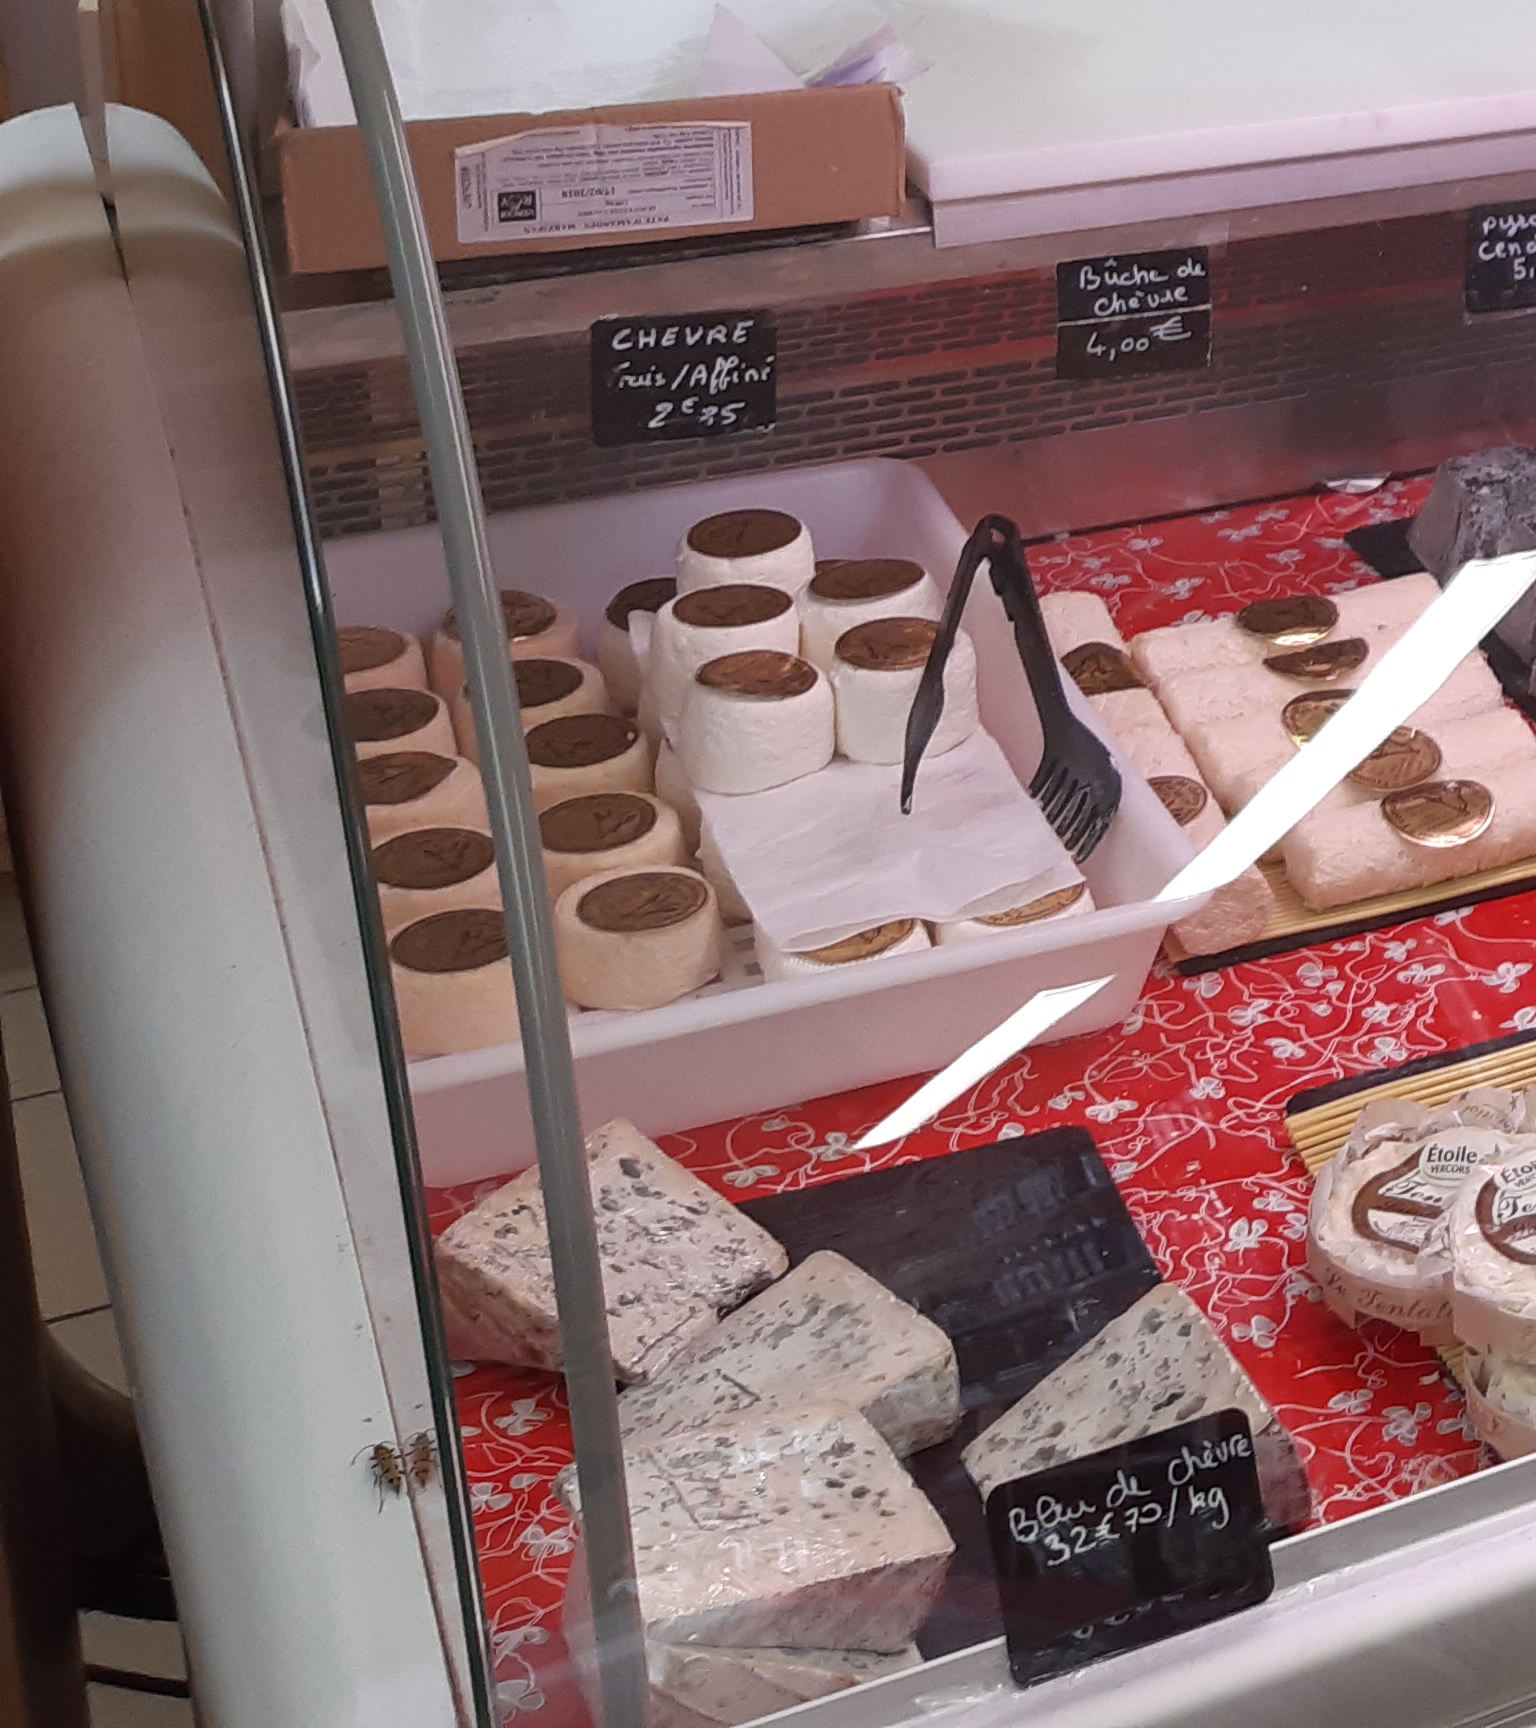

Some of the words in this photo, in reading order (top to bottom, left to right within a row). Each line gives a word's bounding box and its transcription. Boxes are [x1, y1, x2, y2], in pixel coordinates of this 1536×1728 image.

[1079, 258, 1169, 290] Bûche
[1176, 257, 1206, 278] de
[611, 320, 755, 350] CHEVRE
[1425, 1142, 1479, 1165] Étoile
[1008, 1494, 1097, 1544] Bleu
[1106, 1469, 1152, 1509] de
